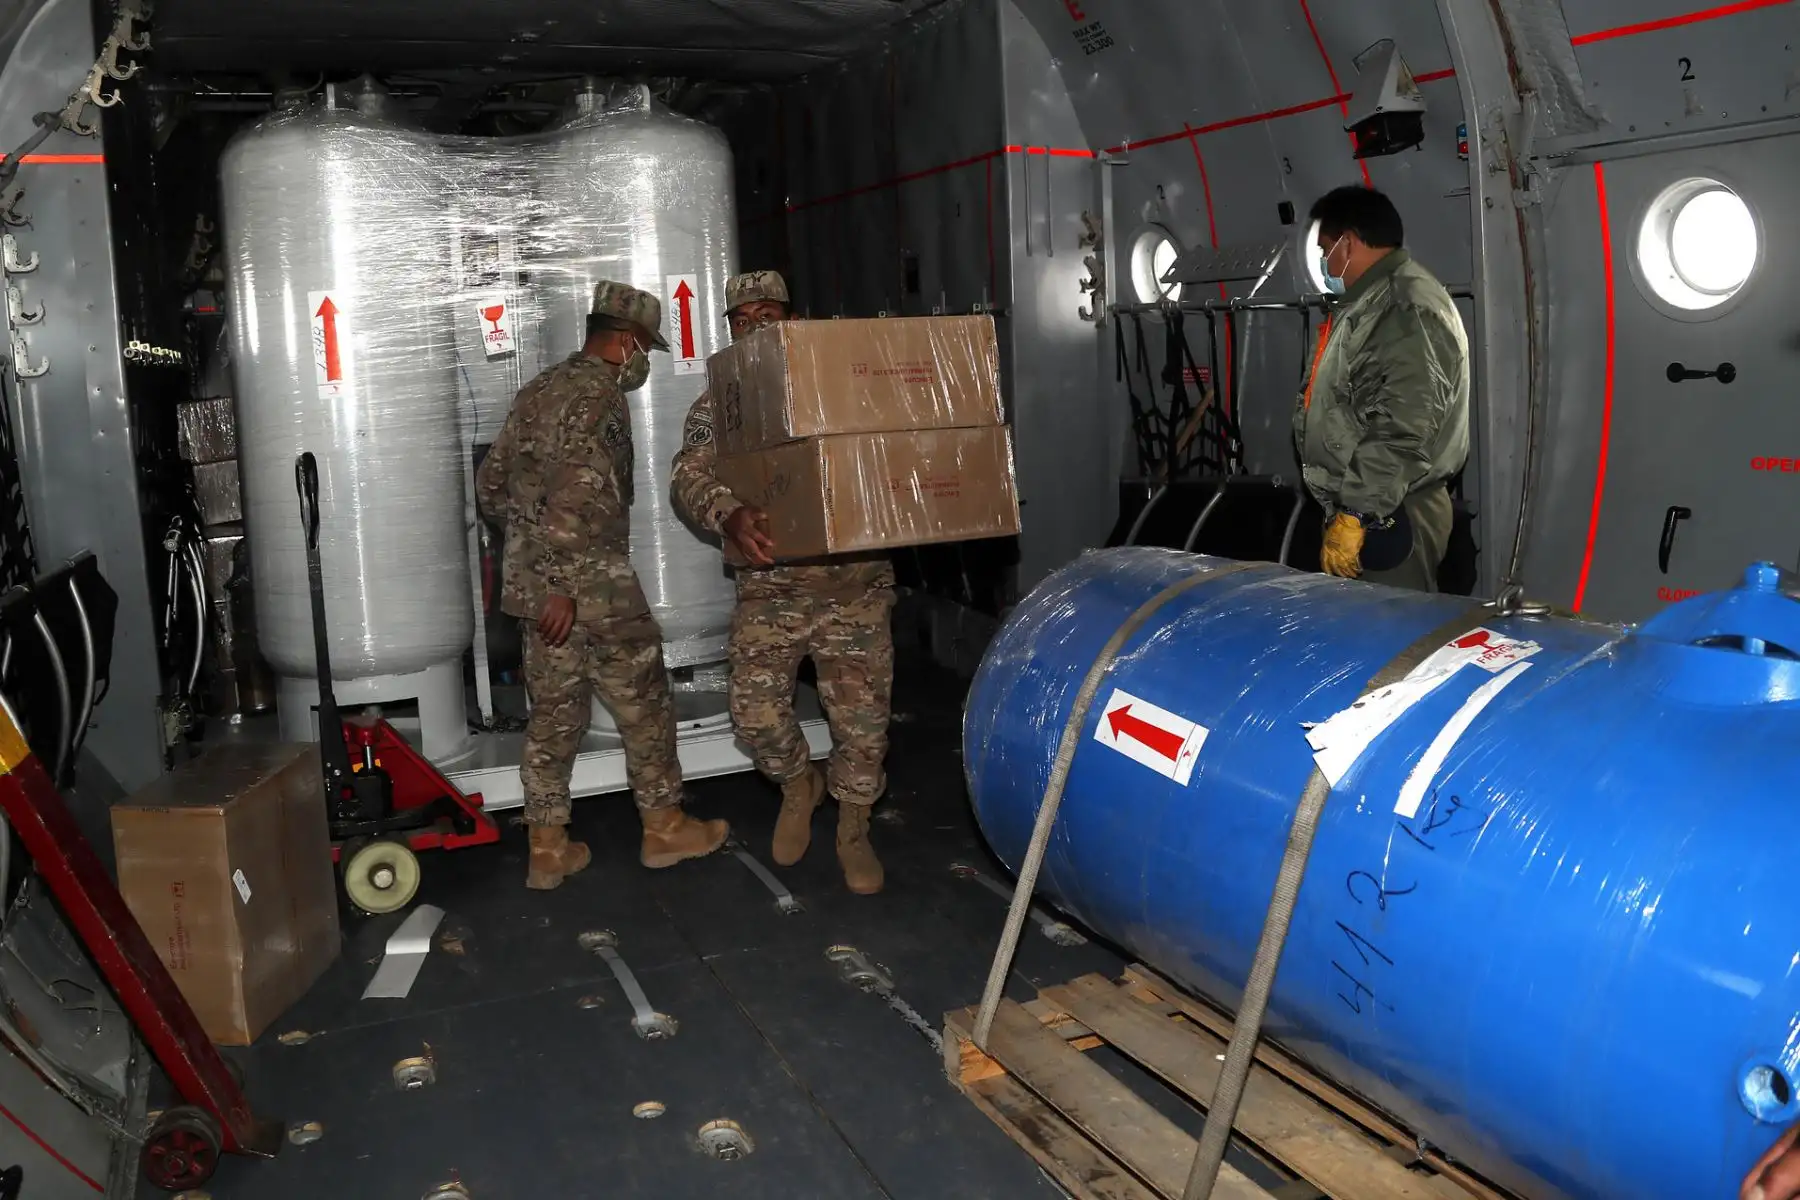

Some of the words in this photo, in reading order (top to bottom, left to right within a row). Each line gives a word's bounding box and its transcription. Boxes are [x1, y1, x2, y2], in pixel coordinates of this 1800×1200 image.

[1678, 56, 1696, 82] 2
[1282, 156, 1293, 175] 3
[1156, 184, 1166, 200] 2
